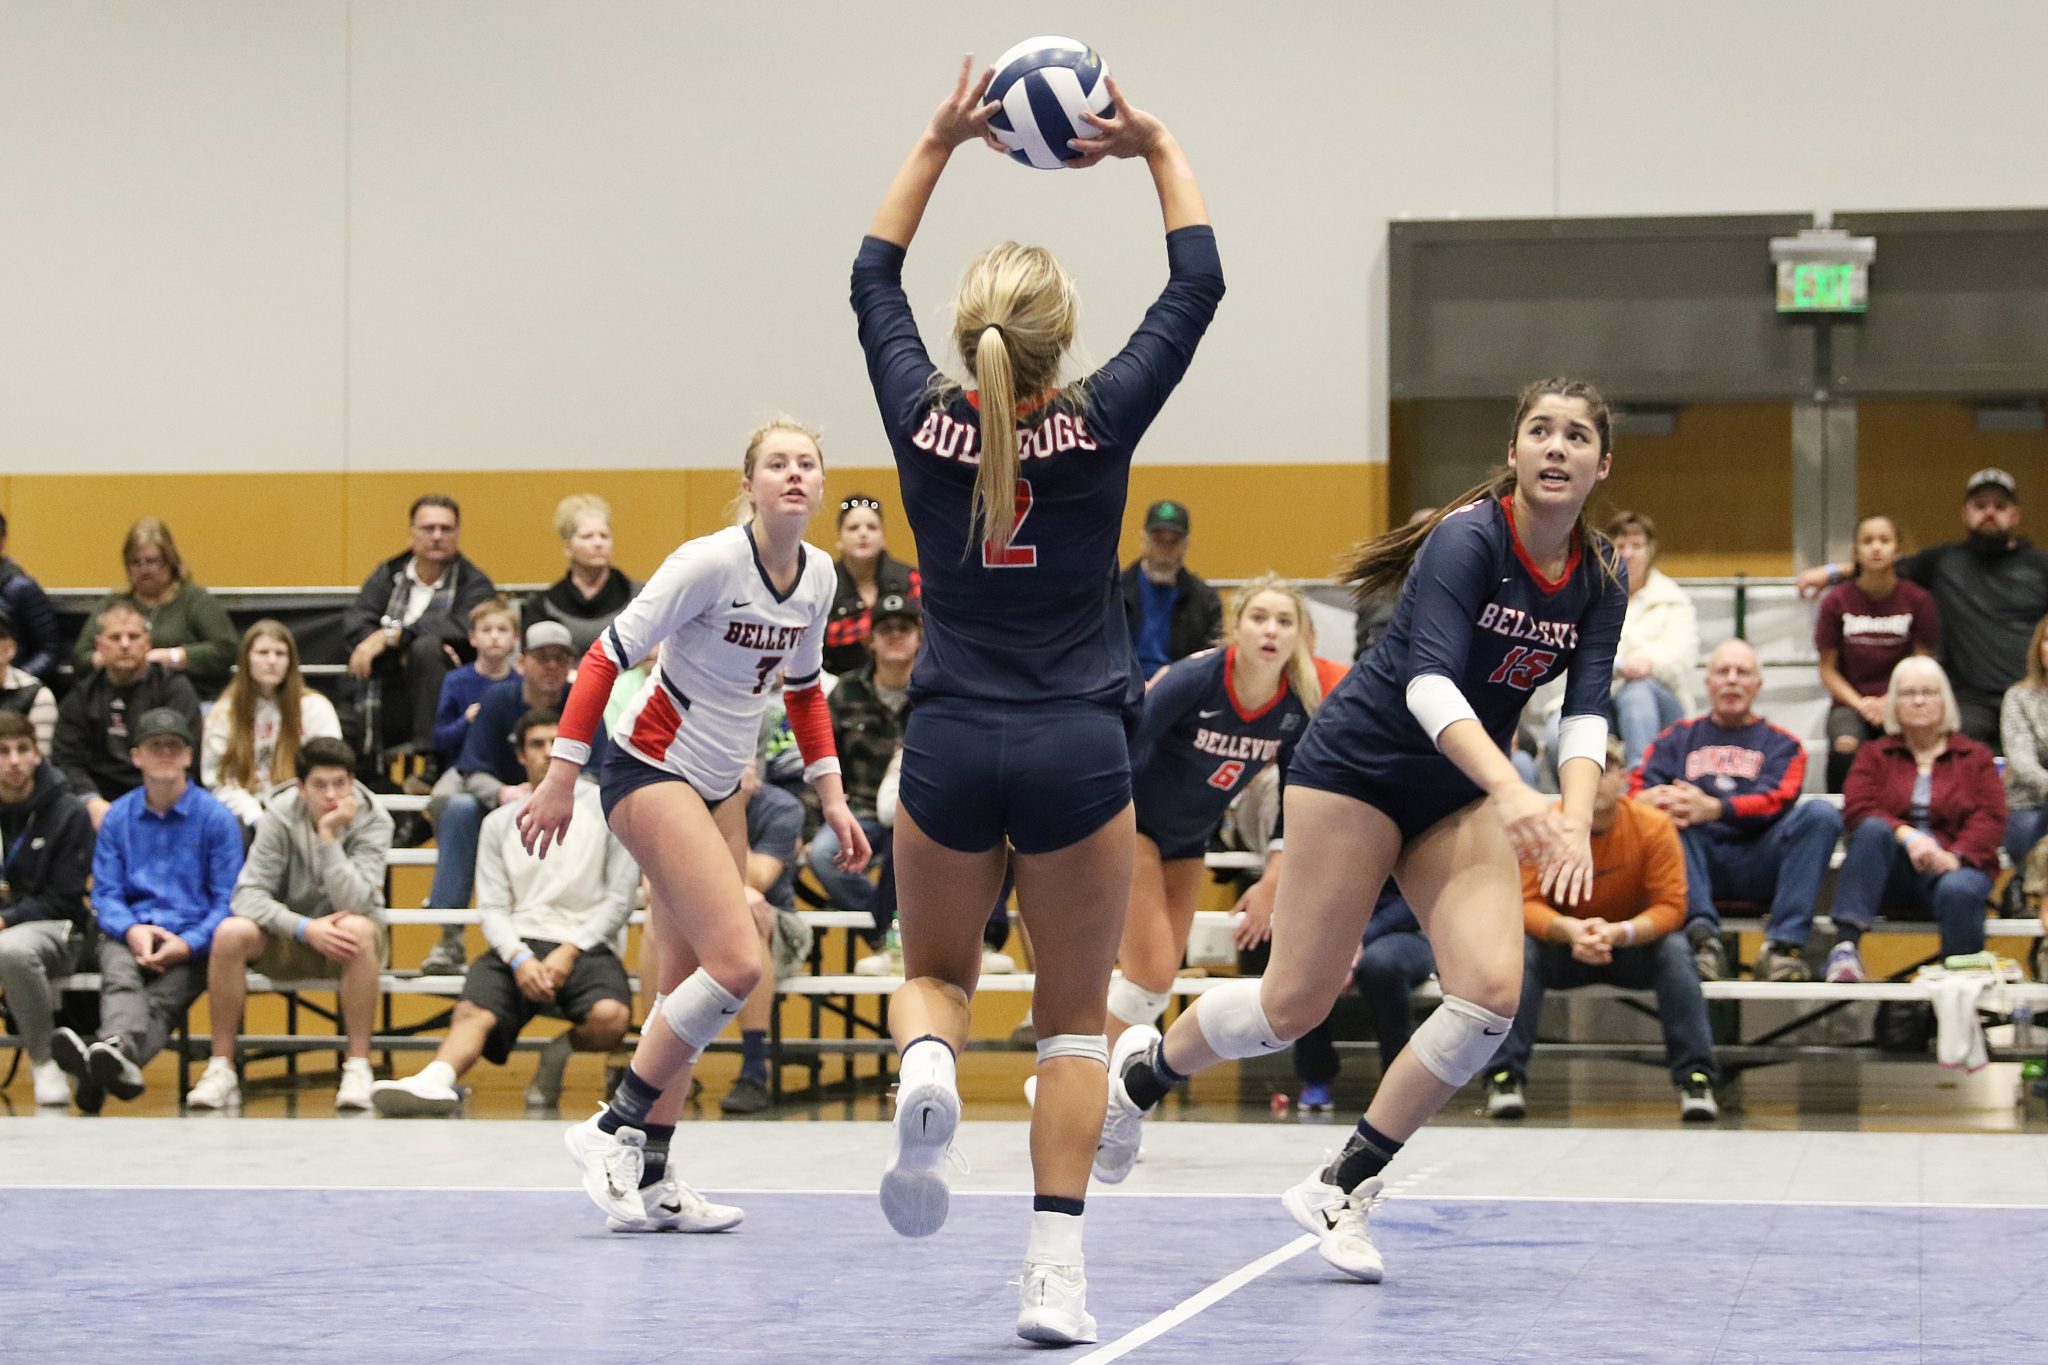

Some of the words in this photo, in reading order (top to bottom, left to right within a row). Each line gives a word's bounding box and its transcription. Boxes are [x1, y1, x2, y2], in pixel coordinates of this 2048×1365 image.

[1794, 264, 1855, 307] EXIT
[912, 411, 1097, 464] BULDOGS
[982, 478, 1037, 568] 2
[723, 621, 808, 650] BELLEV
[1477, 603, 1578, 649] BELLEV
[752, 656, 783, 694] 7
[1488, 645, 1557, 691] 15
[1207, 760, 1245, 791] 6
